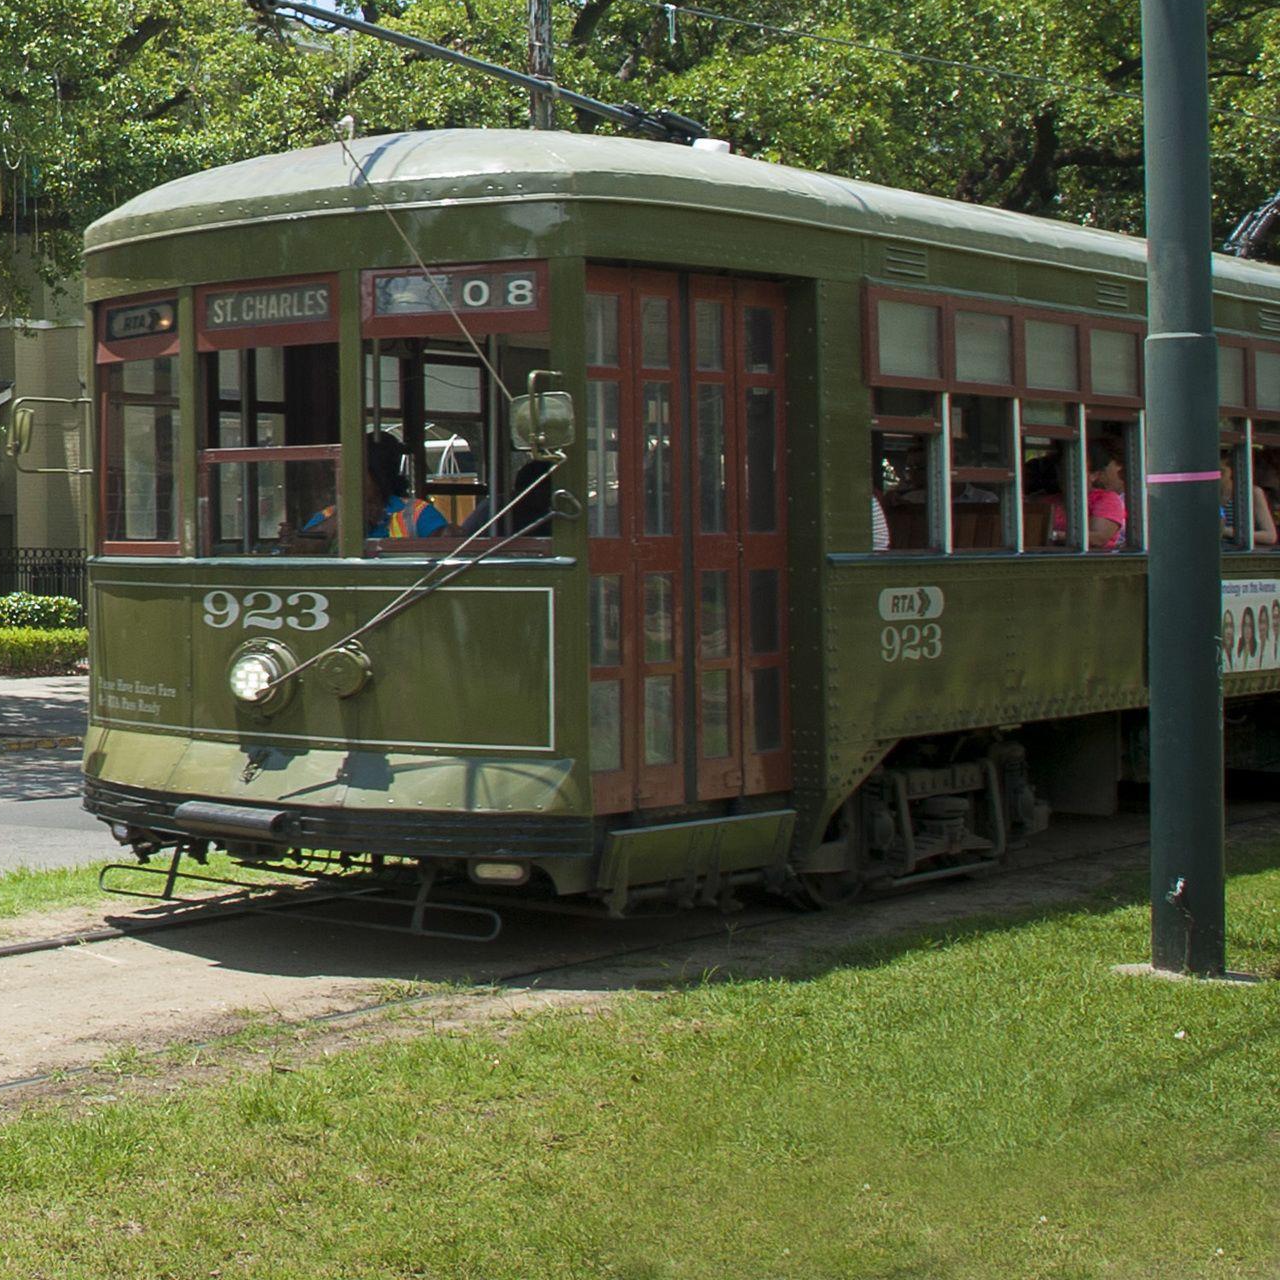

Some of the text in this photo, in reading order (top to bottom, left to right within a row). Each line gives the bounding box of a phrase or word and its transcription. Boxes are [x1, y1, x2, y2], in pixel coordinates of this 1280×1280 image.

[213, 289, 328, 324] ST. CHARLES
[203, 590, 329, 631] 923
[891, 595, 915, 613] RTA
[881, 623, 942, 662] 923
